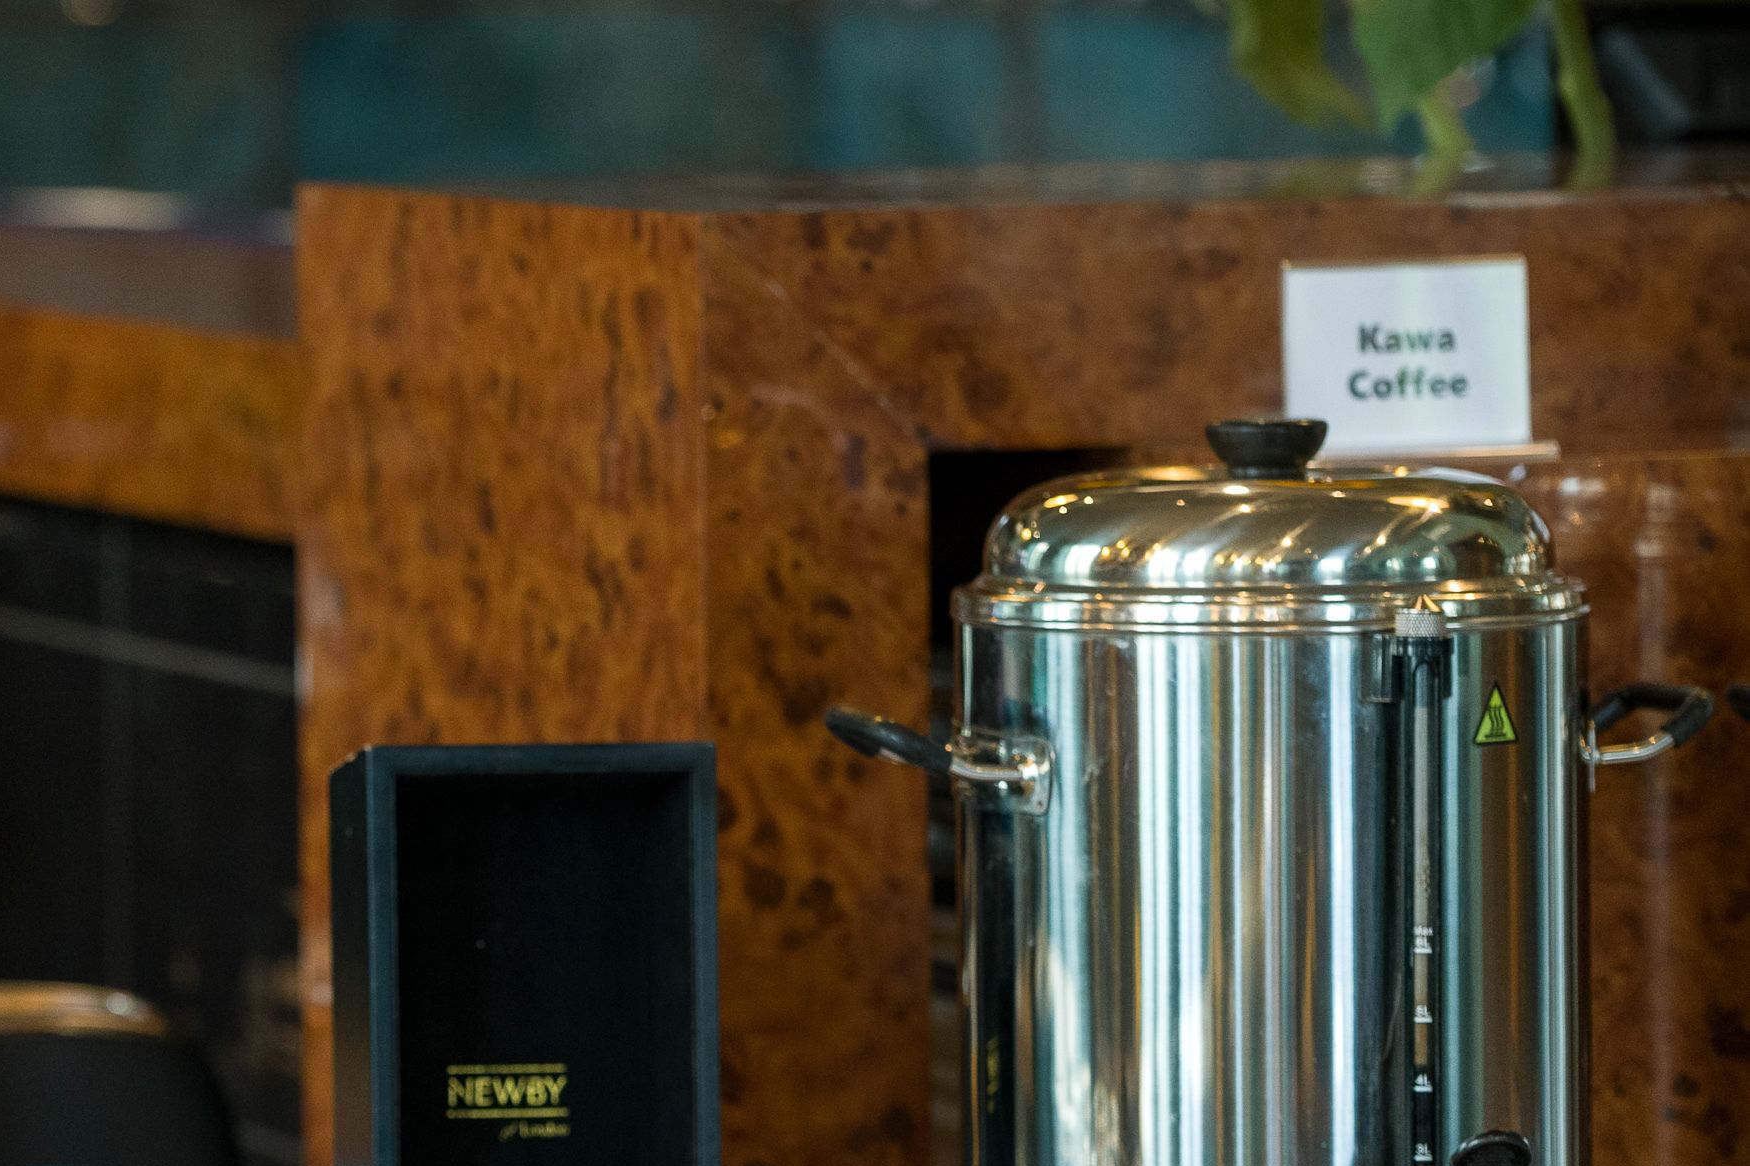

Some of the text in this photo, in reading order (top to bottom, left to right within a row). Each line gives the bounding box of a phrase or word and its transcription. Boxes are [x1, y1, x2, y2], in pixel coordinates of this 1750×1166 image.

[1358, 323, 1456, 353] Kawa
[1348, 364, 1468, 400] Coffee
[448, 1075, 567, 1107] NEWBY
